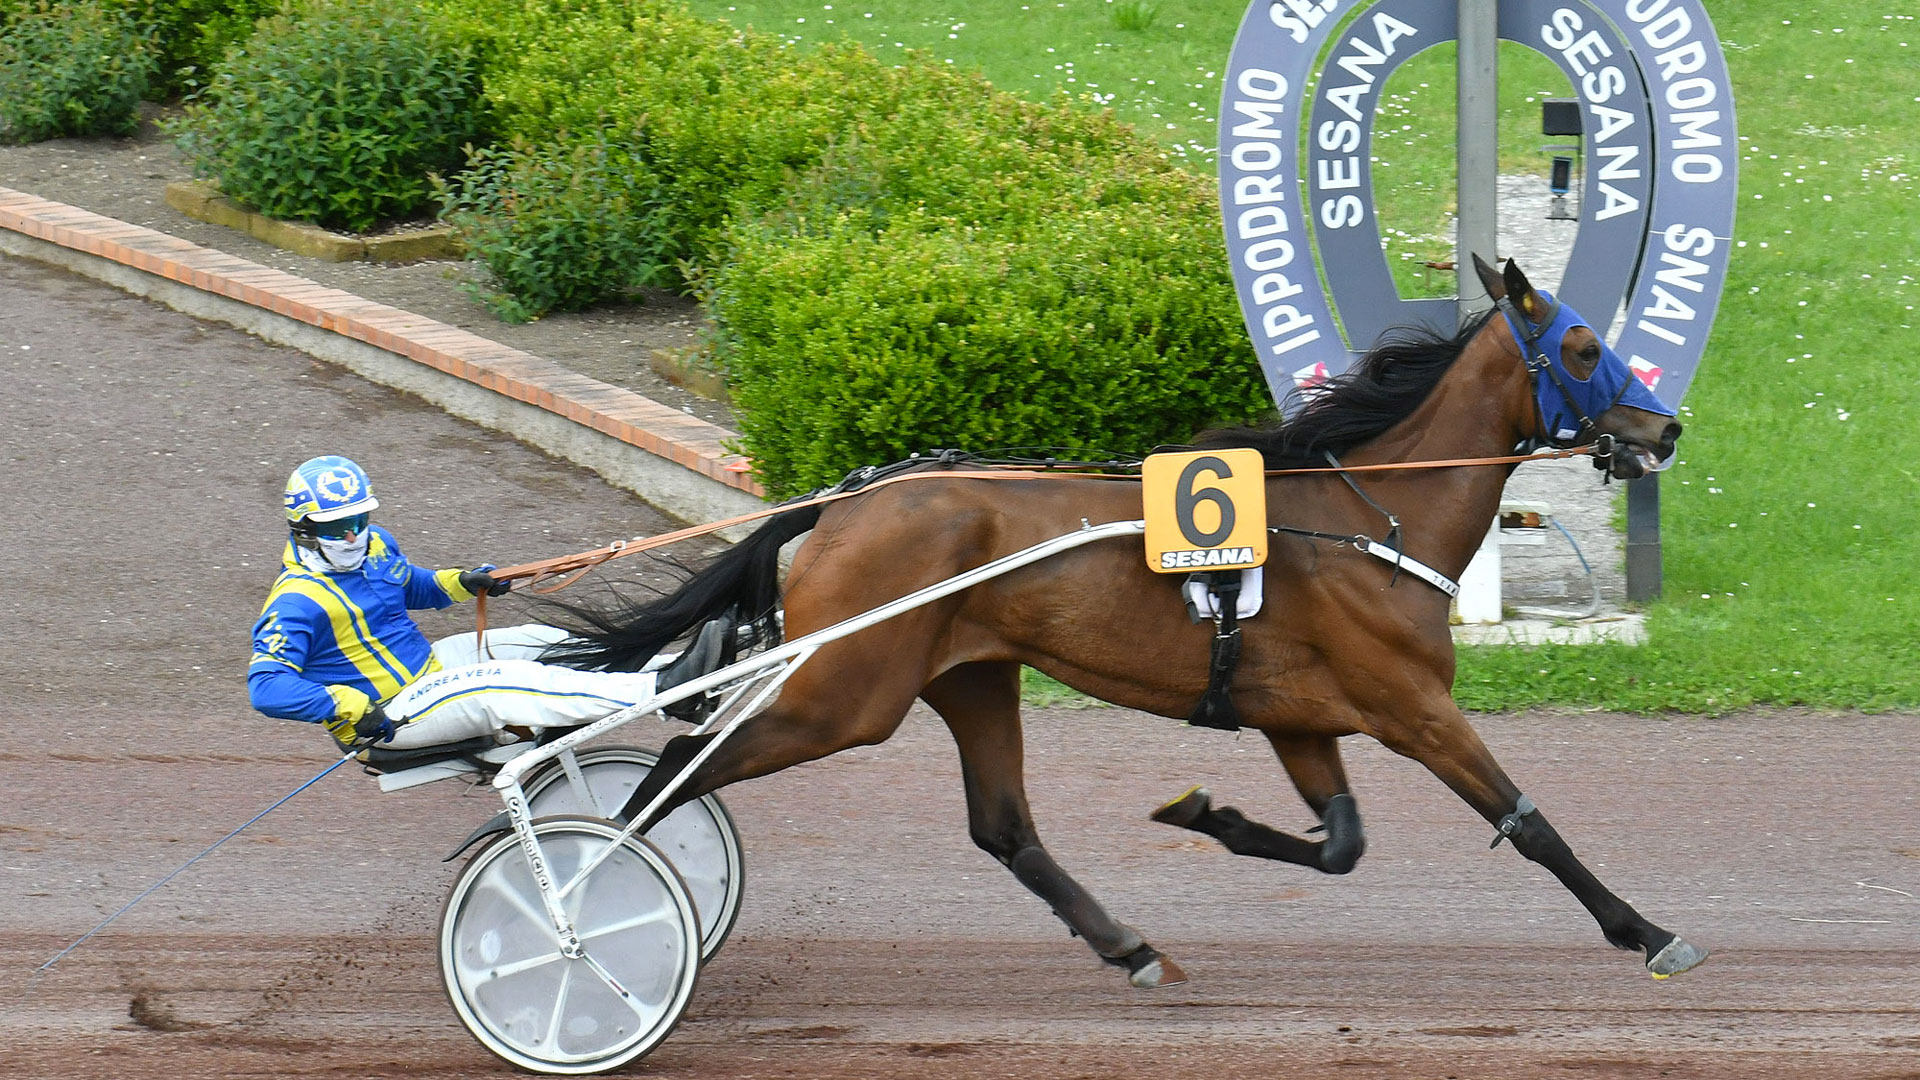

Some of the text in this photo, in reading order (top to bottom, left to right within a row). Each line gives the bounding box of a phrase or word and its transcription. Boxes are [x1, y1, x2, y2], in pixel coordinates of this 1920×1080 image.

[1319, 13, 1417, 229] SESANA
[1541, 9, 1641, 220] SESANA
[1231, 0, 1338, 354] IPPODROMO SE
[1638, 223, 1714, 346] SNAI
[1161, 548, 1254, 568] SESANA
[1175, 456, 1236, 548] 6
[408, 668, 502, 702] ANDREA VEIA
